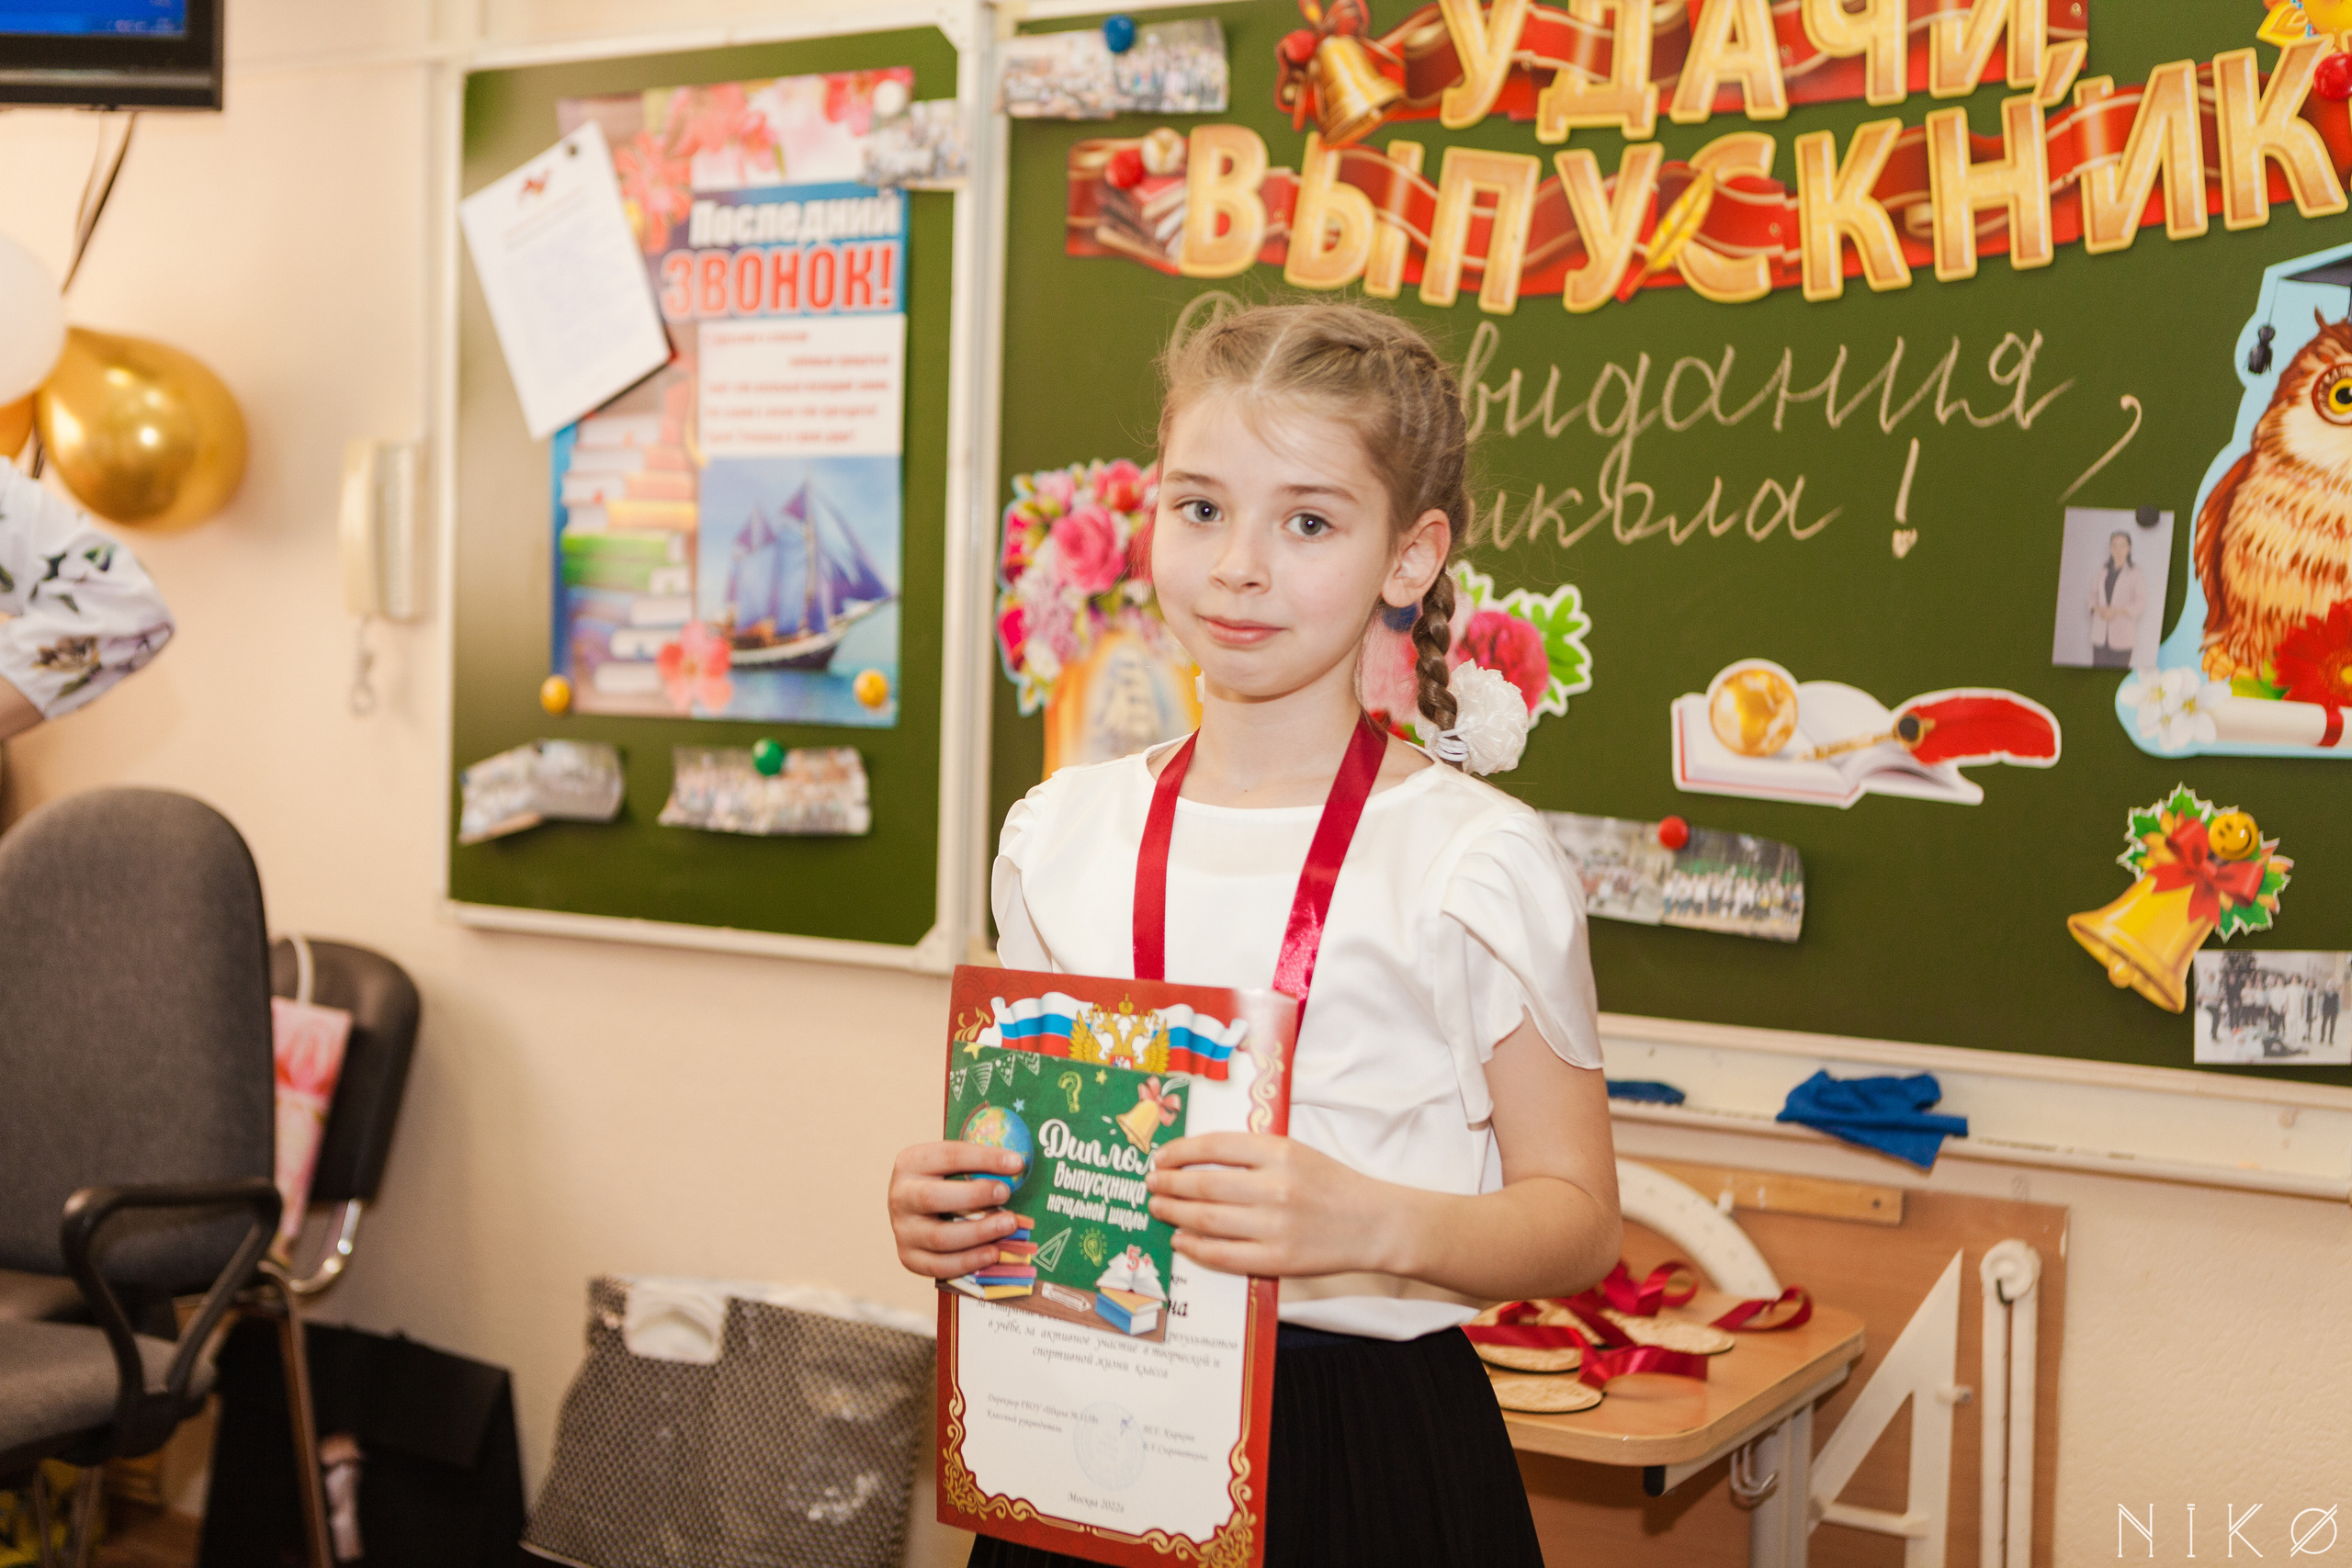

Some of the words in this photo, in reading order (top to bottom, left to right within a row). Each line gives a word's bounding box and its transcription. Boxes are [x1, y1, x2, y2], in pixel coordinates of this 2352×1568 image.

[1178, 29, 2352, 314] ВЫПУСКНИК
[689, 189, 900, 250] Последний
[661, 241, 899, 320] ЗВОНОК!
[1046, 1192, 1108, 1224] начальной
[1107, 1205, 1150, 1233] школы
[1024, 1325, 1036, 1337] за
[1040, 1328, 1091, 1345] активное
[1095, 1336, 1138, 1355] участие
[1031, 1343, 1094, 1365] спортивной
[1094, 1354, 1131, 1373] жизни
[1133, 1362, 1170, 1381] класса
[1068, 1491, 1100, 1509] Москва
